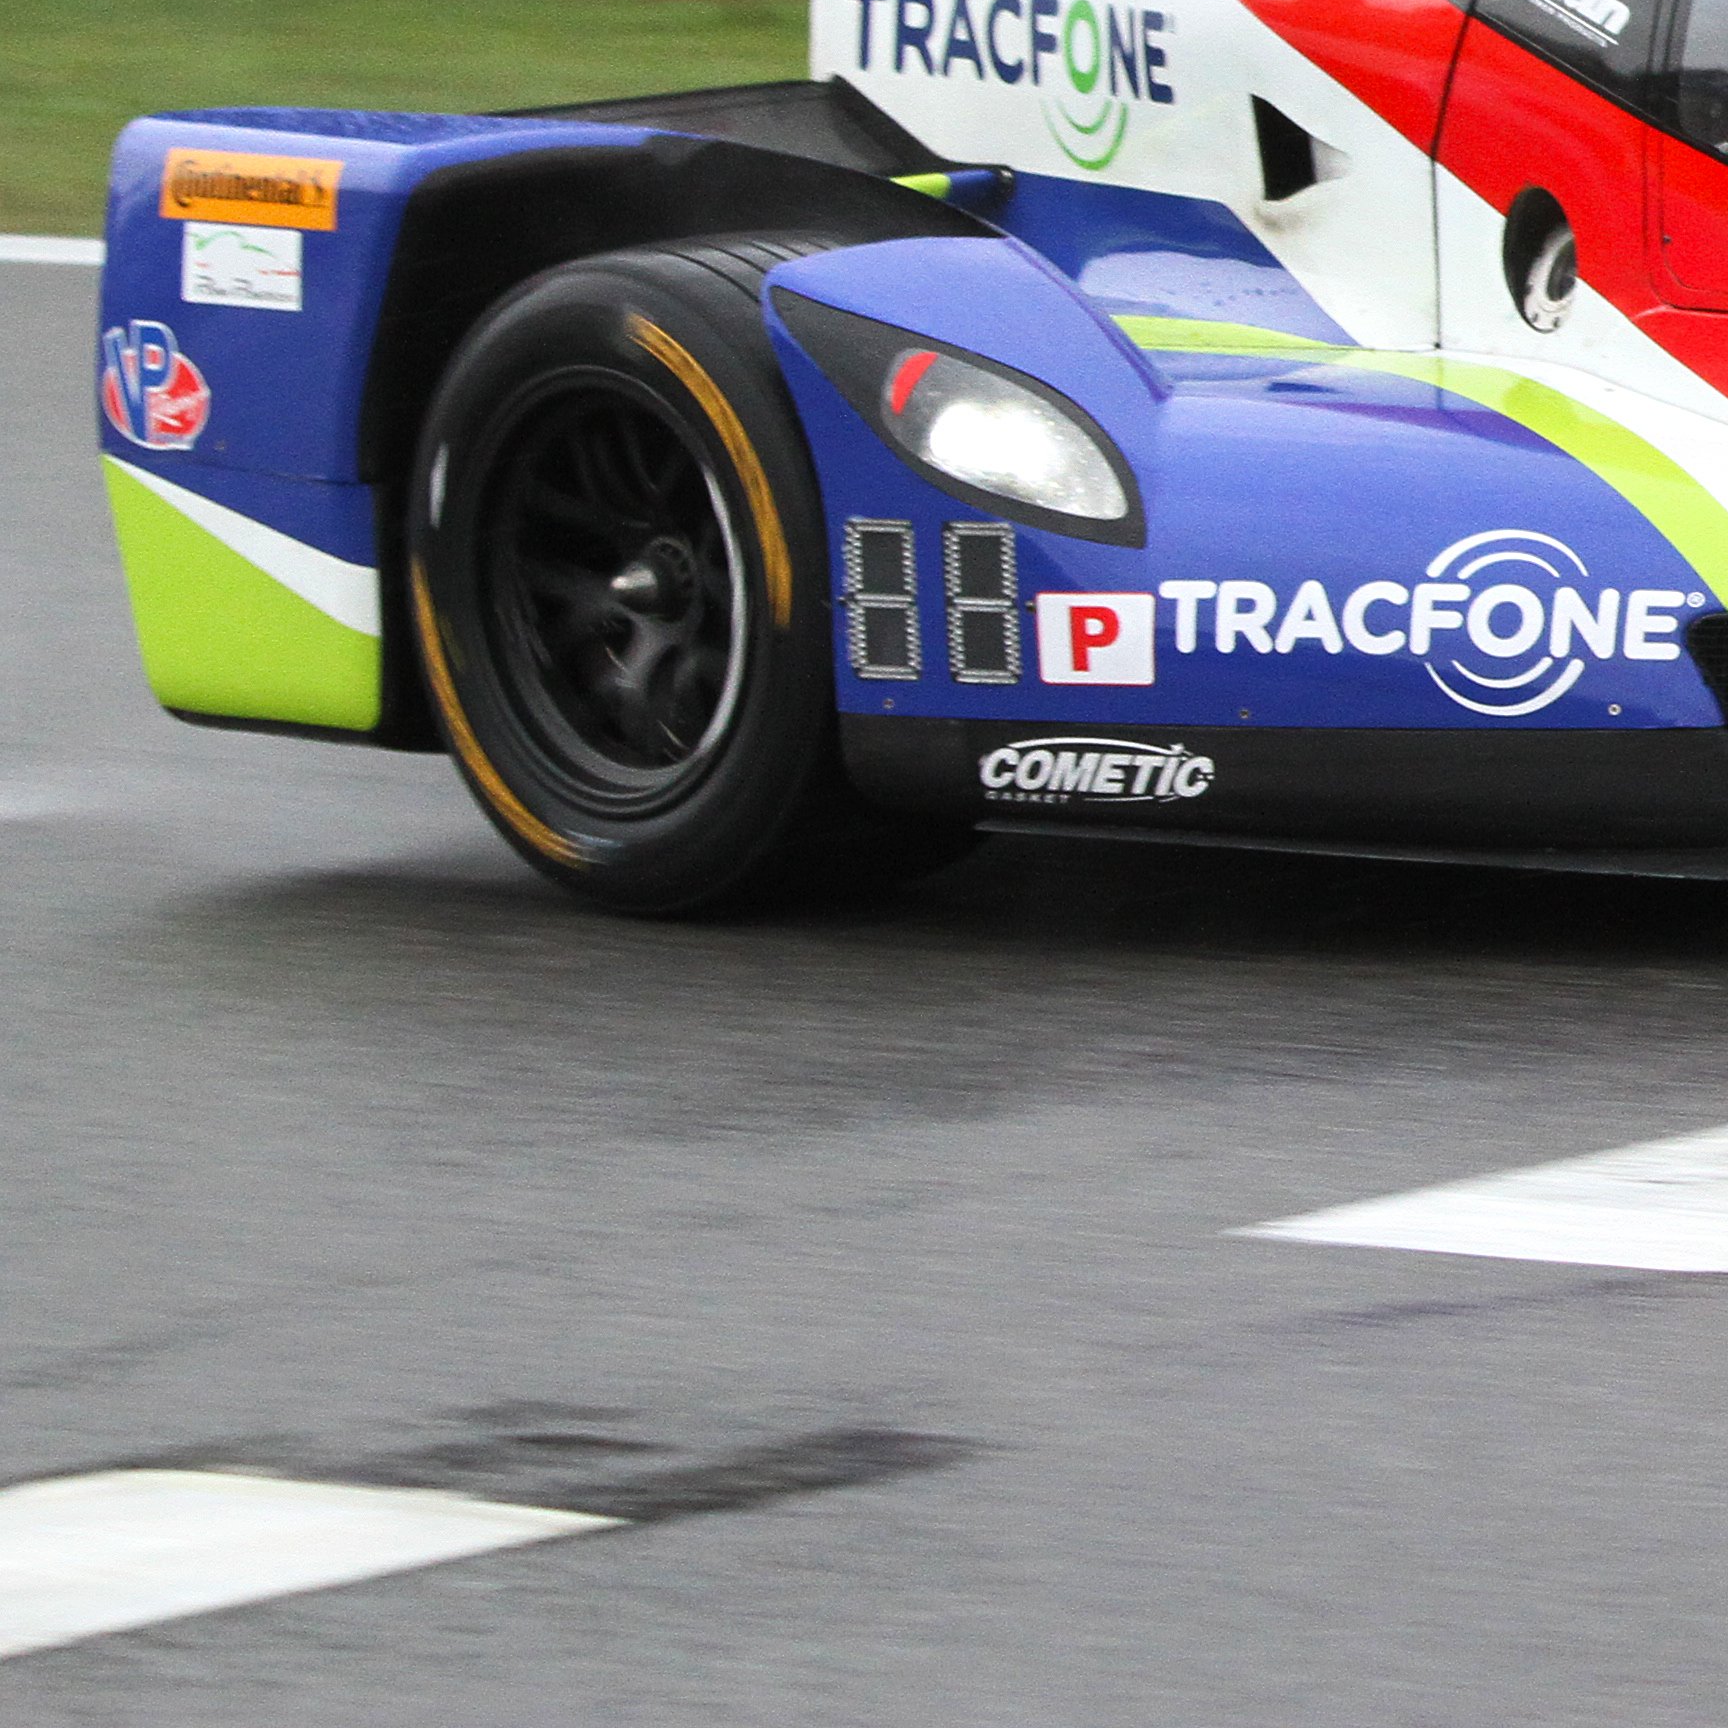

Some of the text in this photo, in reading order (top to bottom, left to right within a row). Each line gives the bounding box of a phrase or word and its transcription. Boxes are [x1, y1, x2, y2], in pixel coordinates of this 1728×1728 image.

[1069, 606, 1121, 672] P
[979, 747, 1215, 798] COMETIC
[984, 790, 1072, 804] GASKET
